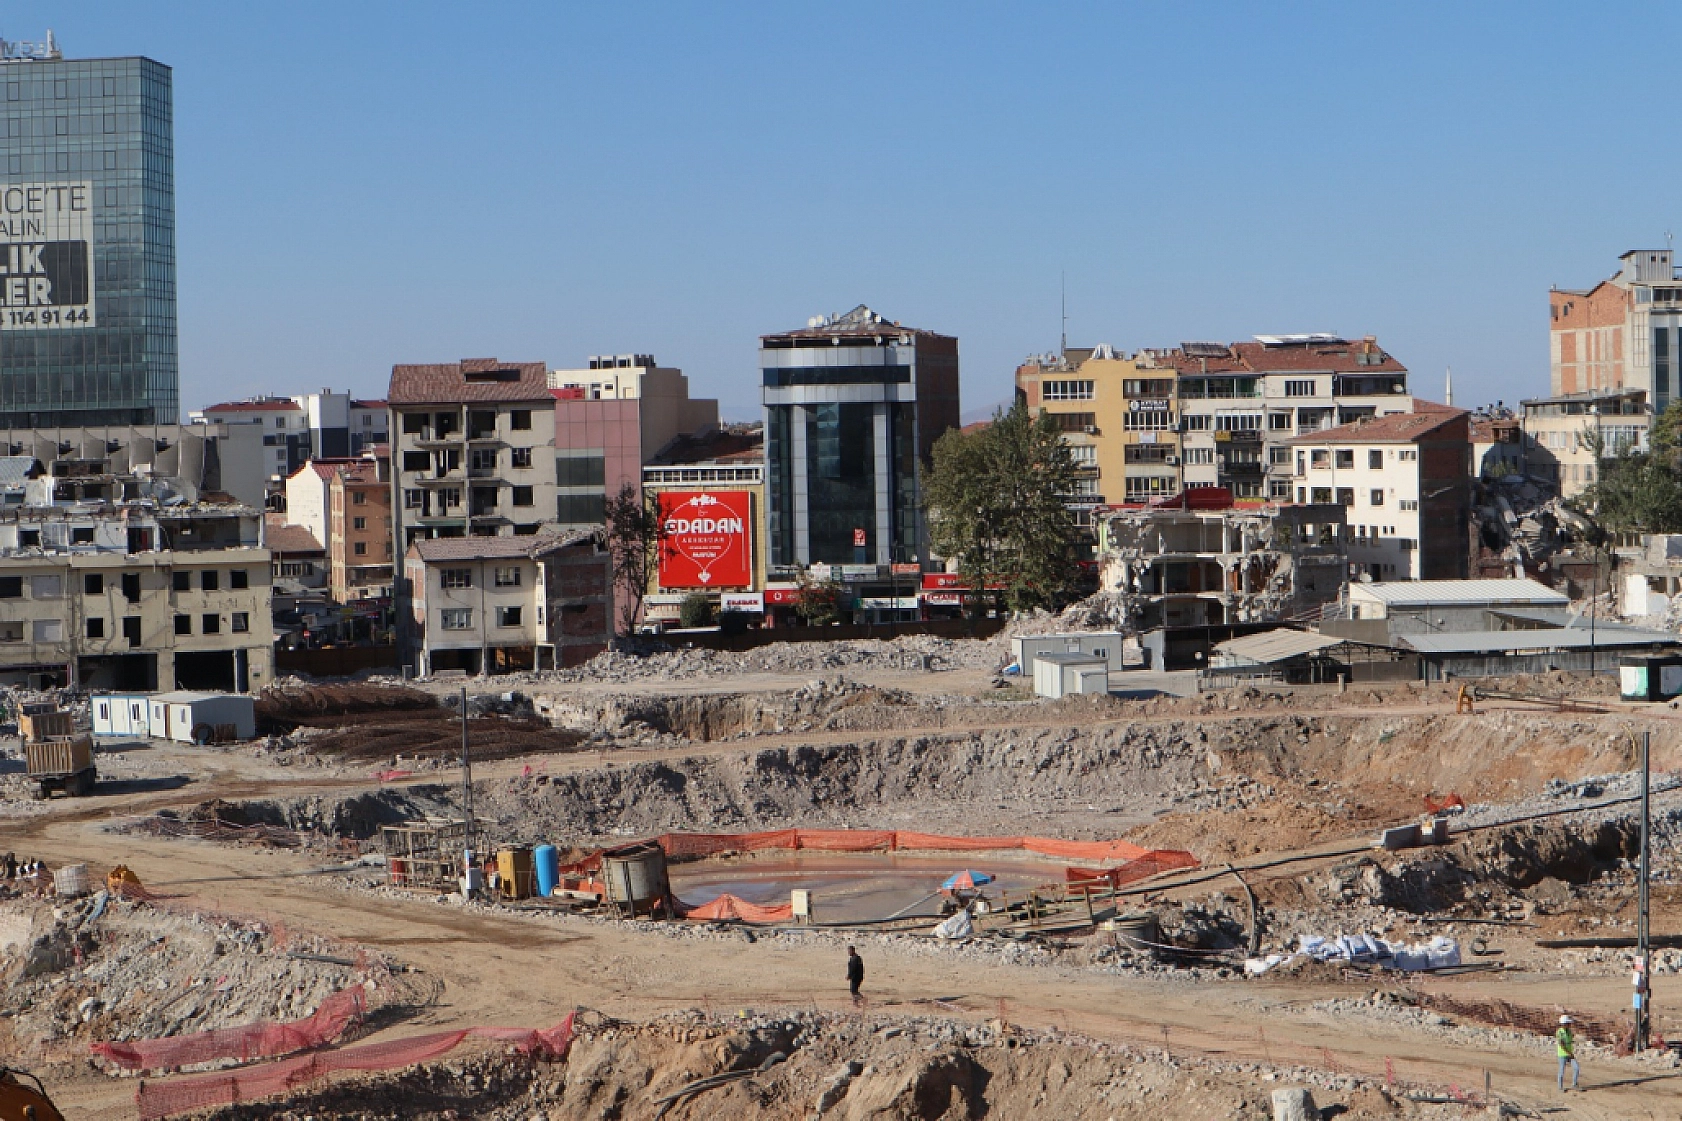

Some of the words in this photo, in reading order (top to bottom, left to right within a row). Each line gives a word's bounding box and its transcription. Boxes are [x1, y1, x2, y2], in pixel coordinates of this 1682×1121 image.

[9, 311, 36, 325] 114
[41, 309, 60, 324] 91
[65, 308, 90, 323] 44
